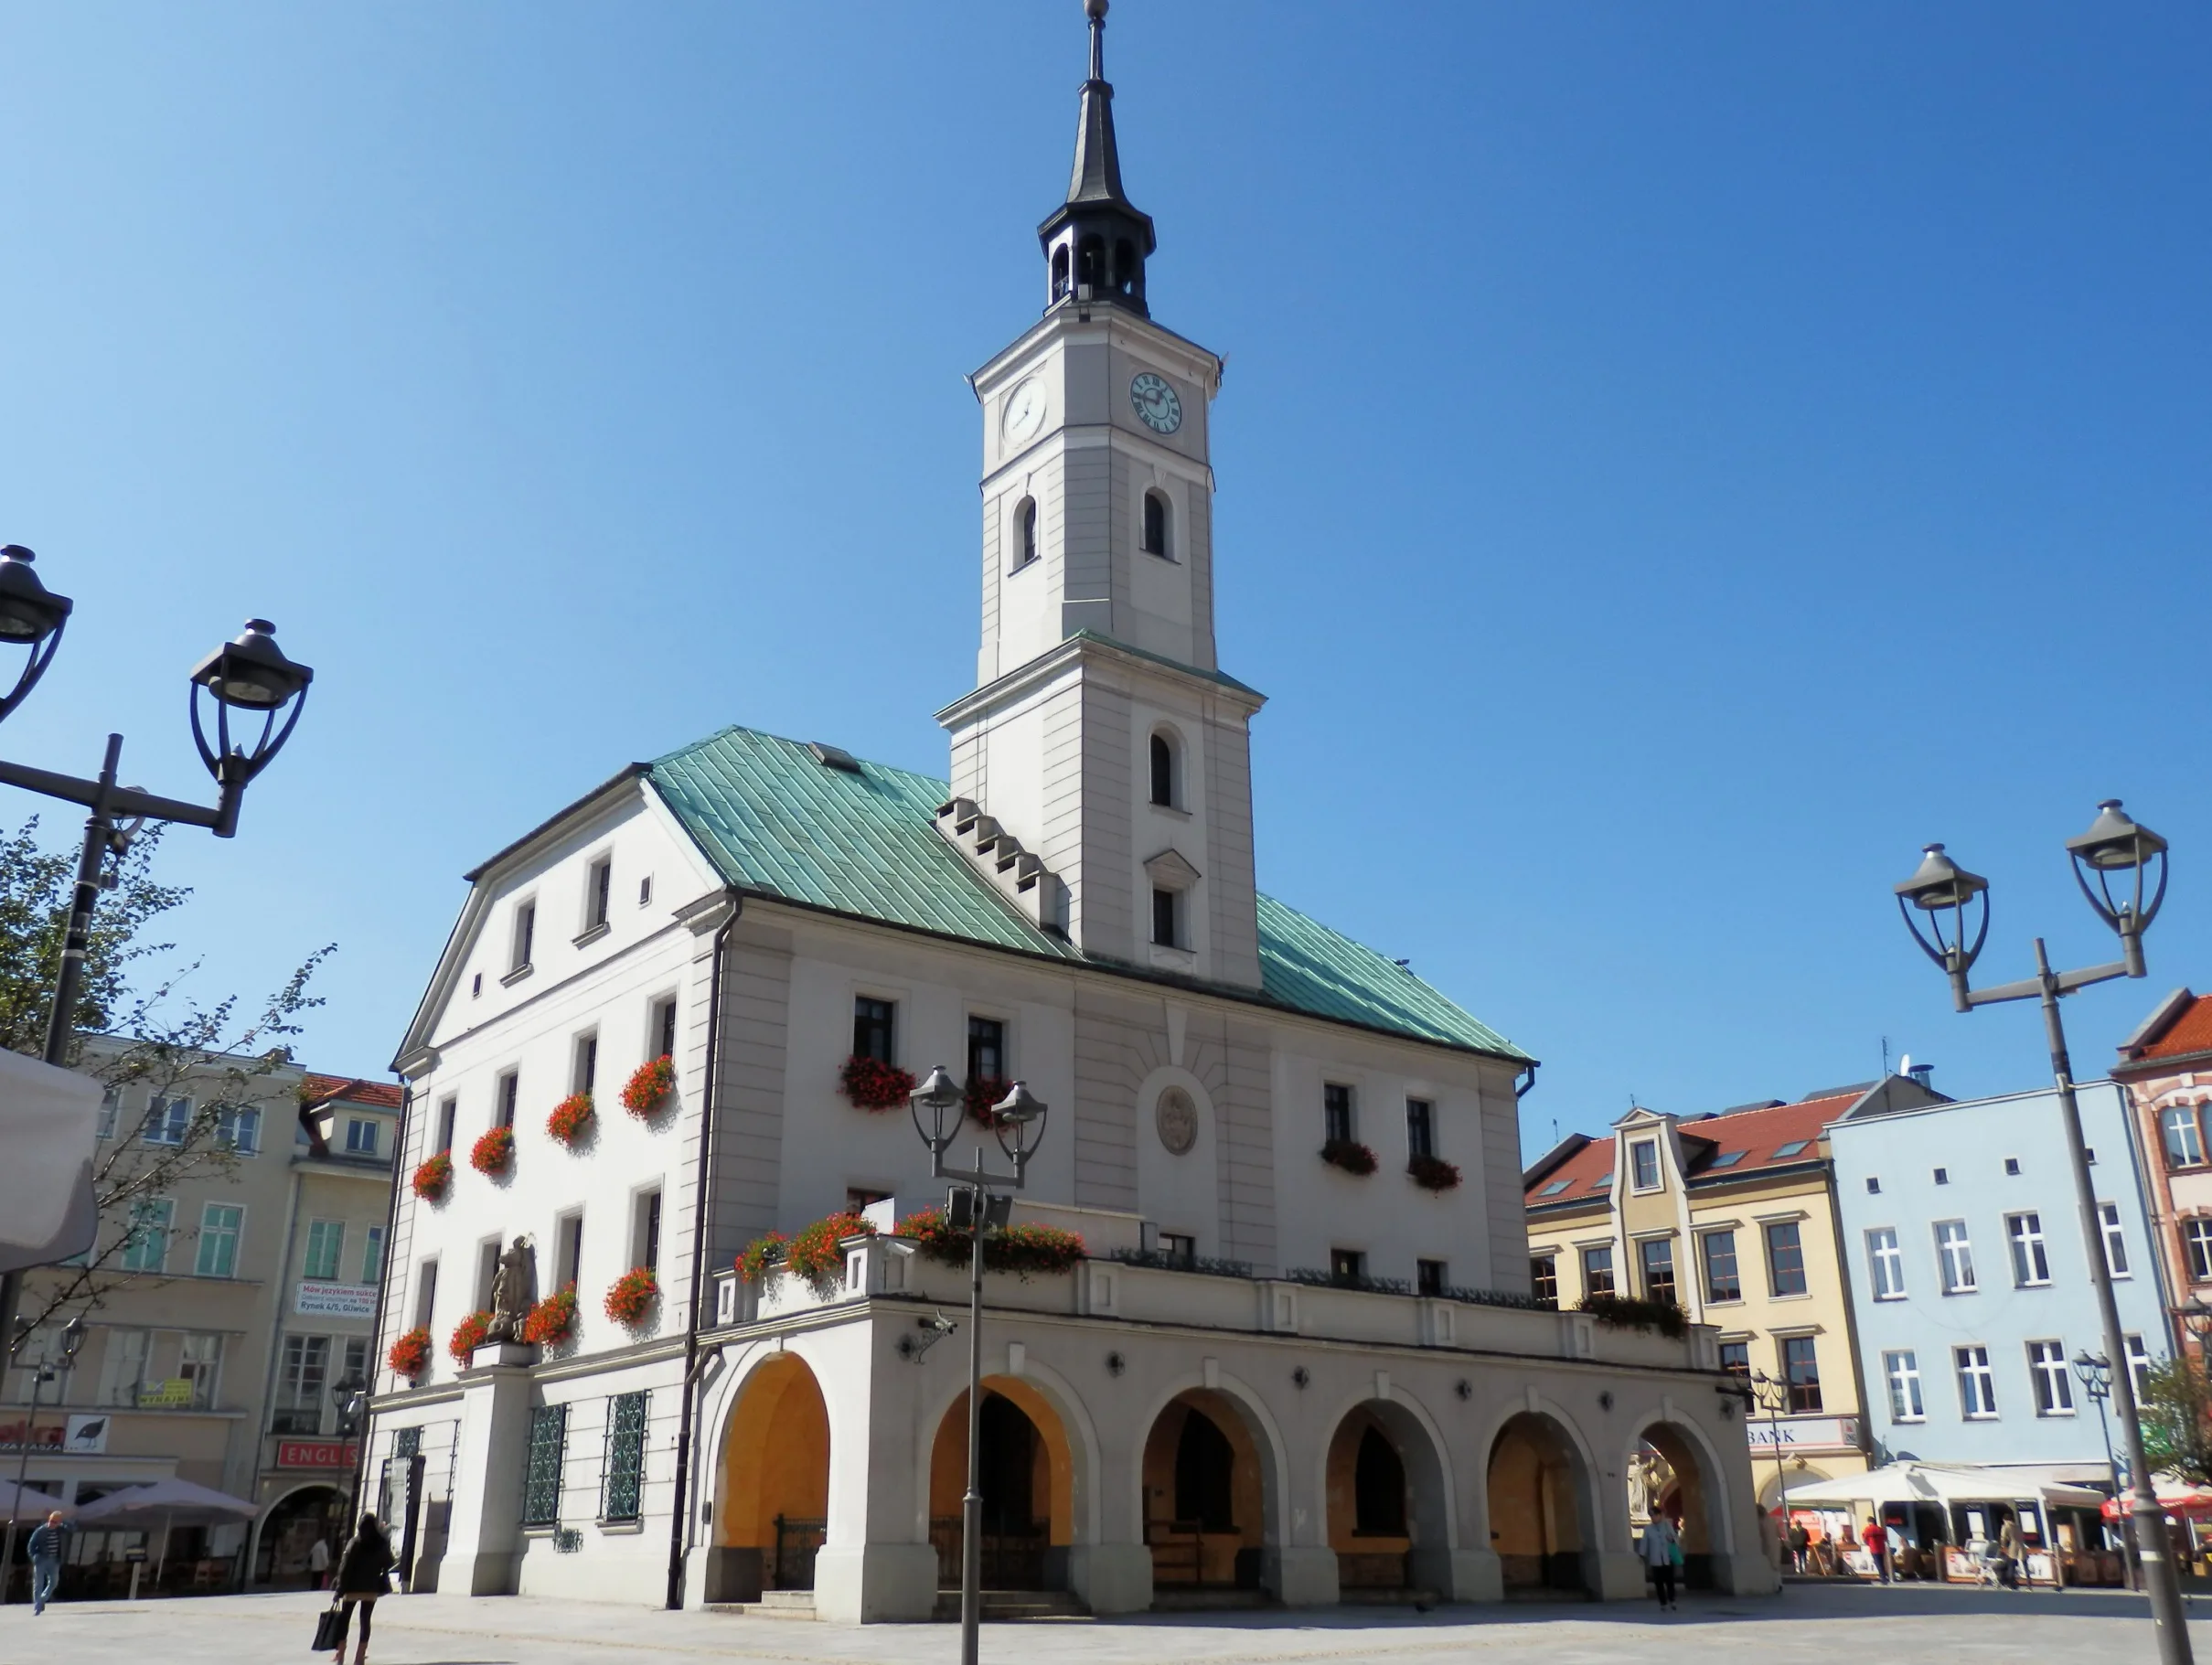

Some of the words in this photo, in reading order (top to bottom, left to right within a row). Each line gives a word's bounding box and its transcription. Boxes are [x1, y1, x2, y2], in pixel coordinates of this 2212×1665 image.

[301, 1301, 324, 1310] Rynek
[343, 1305, 369, 1313] Gliwice
[1747, 1429, 1794, 1444] BANK
[288, 1446, 358, 1463] ENGLS
